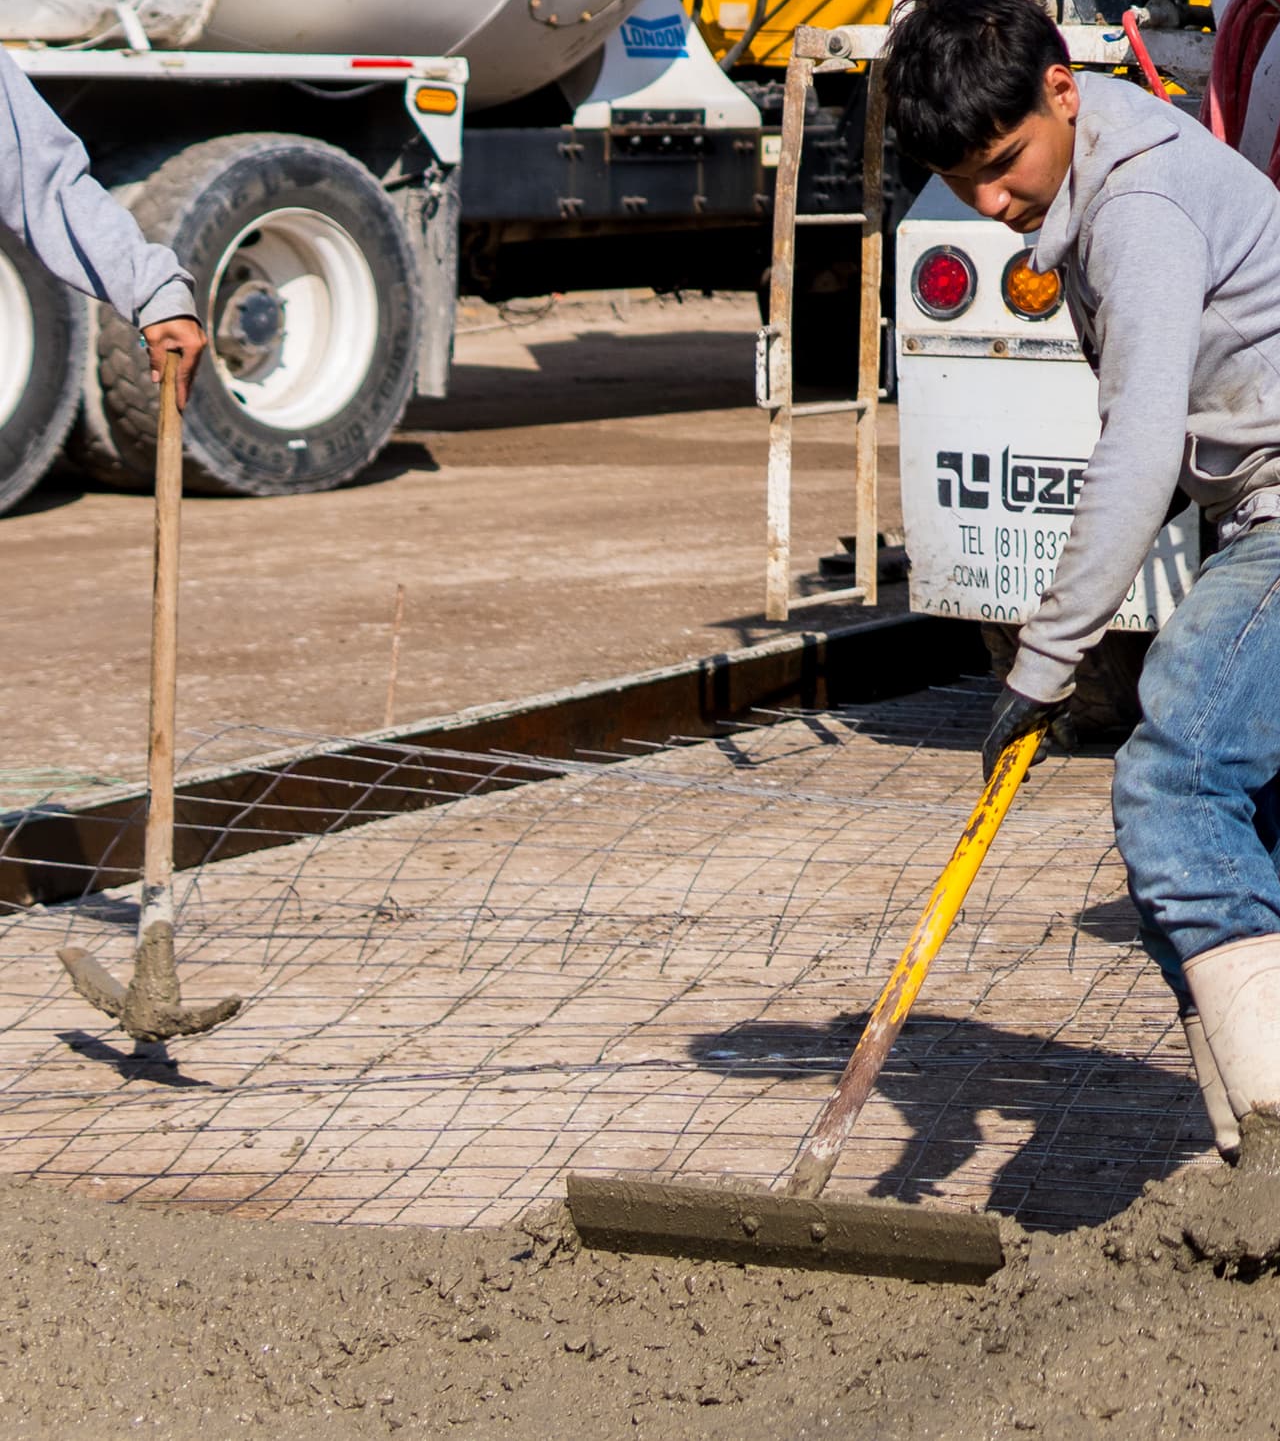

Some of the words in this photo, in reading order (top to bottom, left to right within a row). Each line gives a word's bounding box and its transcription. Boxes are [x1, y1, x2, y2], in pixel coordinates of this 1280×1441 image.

[620, 24, 688, 47] LONDON
[958, 524, 985, 555] TEL
[995, 525, 1028, 565] (81)
[995, 563, 1028, 602] (81)
